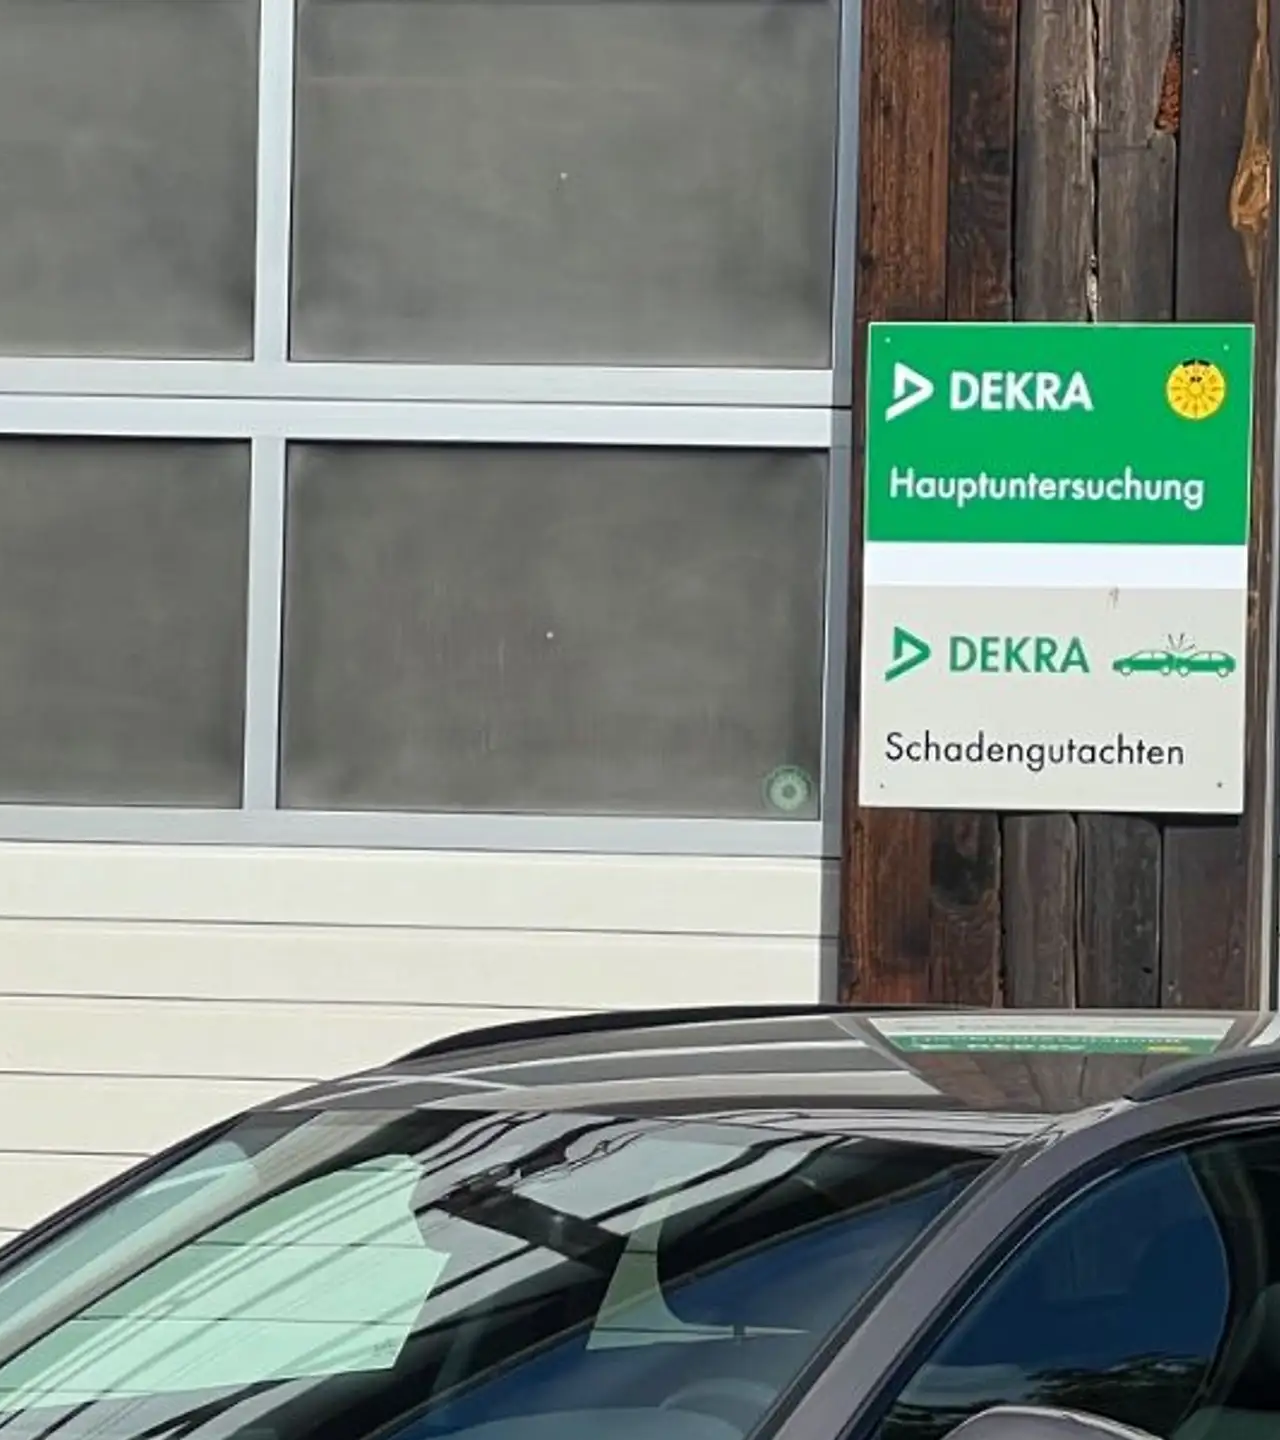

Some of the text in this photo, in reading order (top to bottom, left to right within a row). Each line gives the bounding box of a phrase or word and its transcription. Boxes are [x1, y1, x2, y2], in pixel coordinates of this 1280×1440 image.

[949, 370, 1094, 412] DEKRA
[889, 466, 1205, 510] Hauptuntersuchung
[949, 635, 1090, 674] DEKRA
[885, 729, 1184, 772] Schadengutachten
